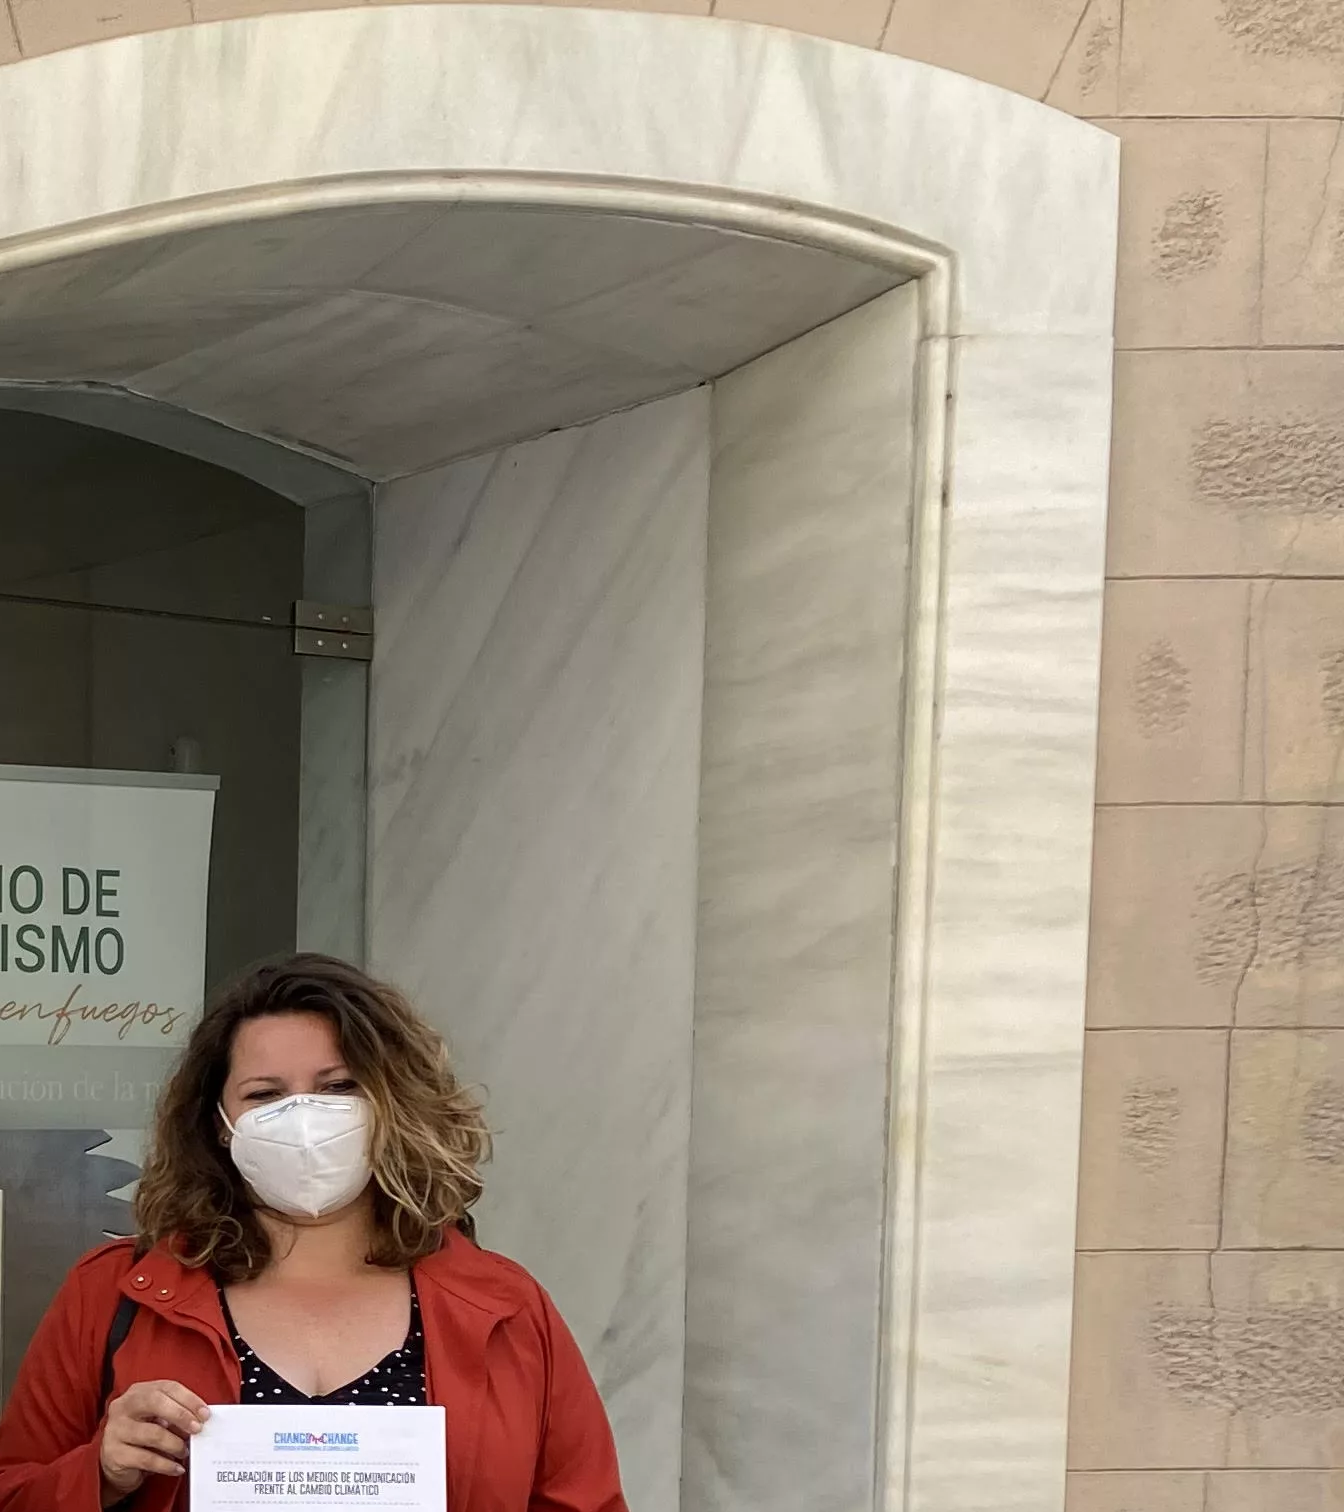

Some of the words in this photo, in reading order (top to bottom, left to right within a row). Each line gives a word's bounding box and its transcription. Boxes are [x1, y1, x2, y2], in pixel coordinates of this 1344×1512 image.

[62, 867, 120, 917] DE
[73, 1071, 104, 1101] de
[112, 1071, 135, 1101] la
[275, 1472, 287, 1483] DE
[288, 1472, 305, 1483] LOS
[306, 1472, 339, 1483] MEDIOS
[340, 1472, 352, 1483] DE
[254, 1484, 284, 1495] FRENTE
[286, 1484, 297, 1495] AL
[299, 1484, 332, 1496] CAMBIO
